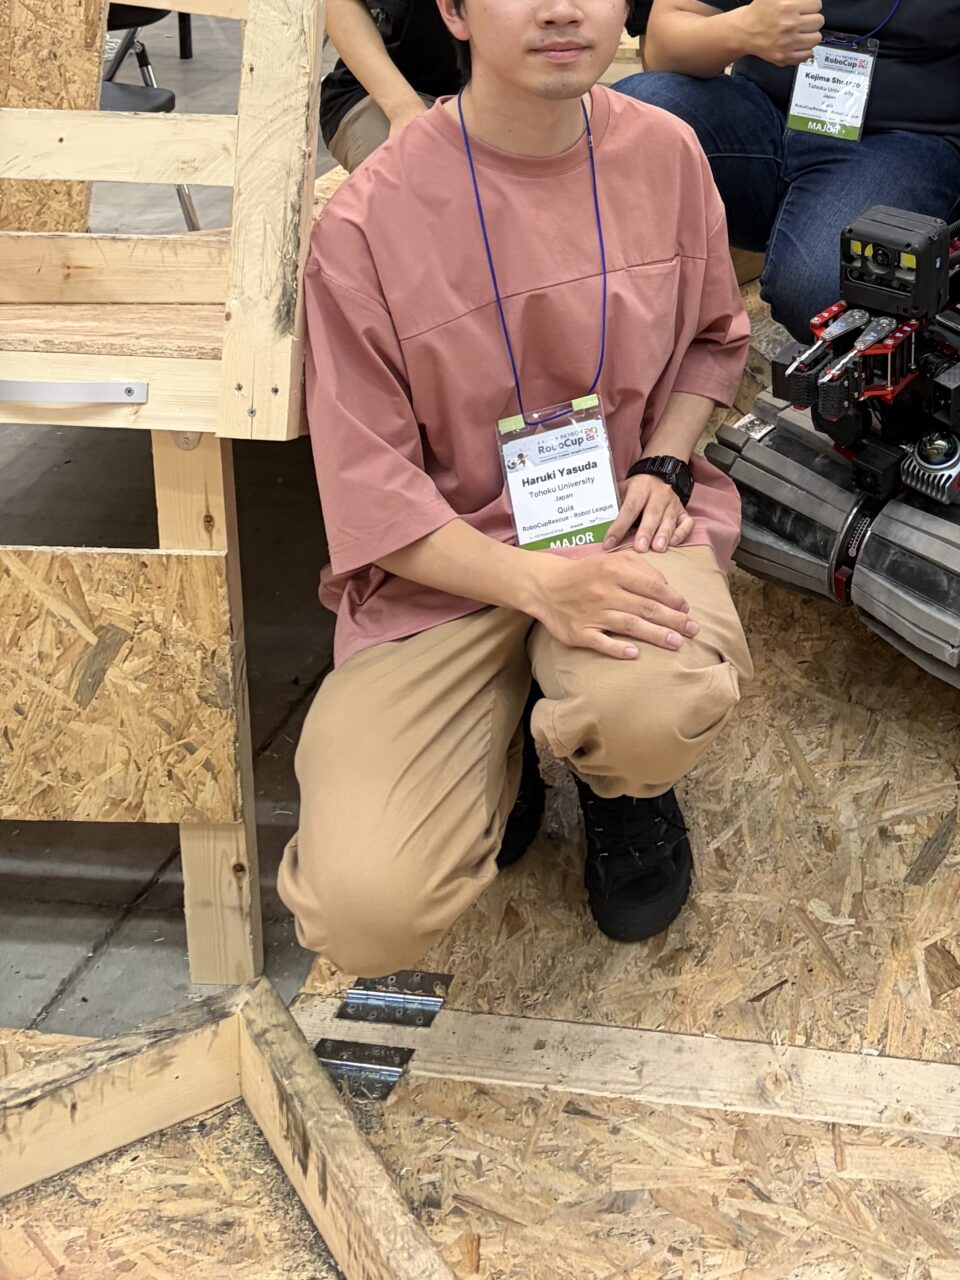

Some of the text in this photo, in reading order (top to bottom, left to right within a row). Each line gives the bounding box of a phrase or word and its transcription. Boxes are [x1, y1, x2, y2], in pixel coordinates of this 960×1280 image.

[824, 56, 858, 69] RoboCup
[807, 121, 840, 134] MAJOR
[522, 461, 598, 488] Haruki Yasuda
[529, 476, 595, 499] Tohoku University
[555, 493, 574, 502] Japan
[557, 504, 575, 514] Quix
[522, 515, 569, 532] RoboCupRescue
[574, 509, 592, 519] Robot
[592, 503, 614, 514] League
[550, 531, 595, 550] MAJOR
